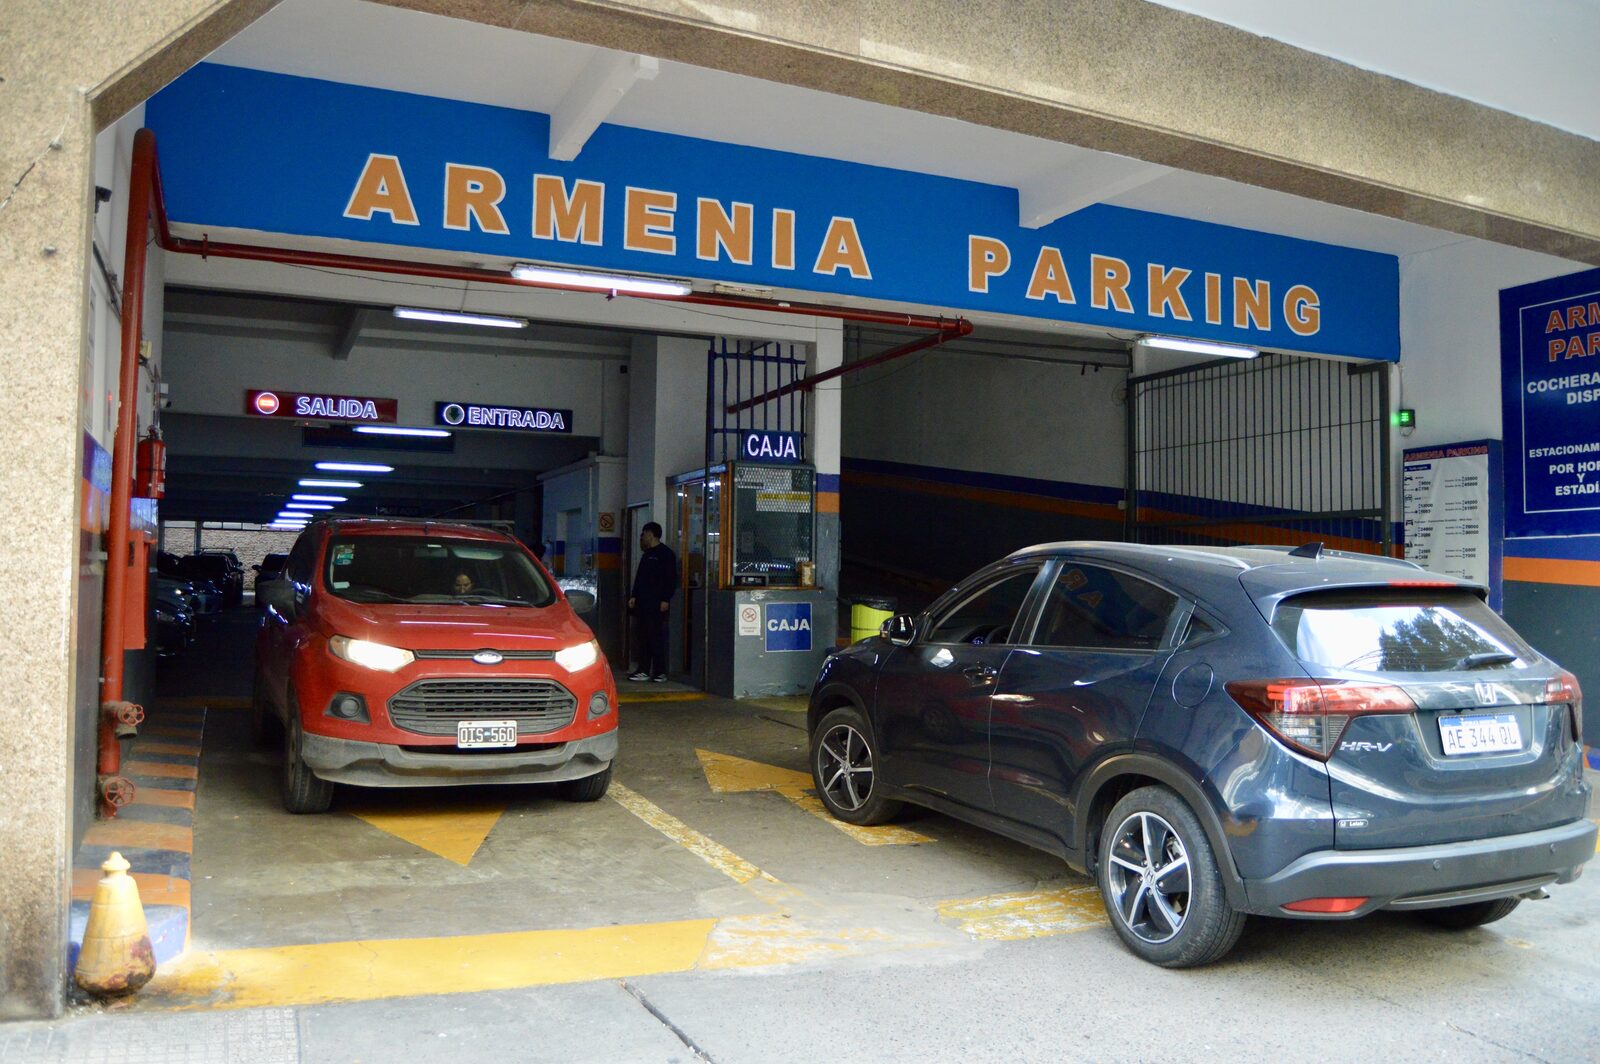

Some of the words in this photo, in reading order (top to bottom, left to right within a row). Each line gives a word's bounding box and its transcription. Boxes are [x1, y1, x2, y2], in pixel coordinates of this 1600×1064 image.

[343, 153, 872, 280] ARMENIA
[968, 234, 1320, 336] PARKING
[1549, 332, 1600, 362] PAR
[1527, 371, 1600, 394] COCHERA
[1566, 388, 1600, 405] DISP
[296, 397, 378, 419] SALIDA
[468, 407, 565, 429] ENTRADA
[747, 433, 797, 458] CAJA
[1529, 442, 1600, 458] ESTACIONAM
[1549, 463, 1575, 475] POR
[1576, 472, 1586, 483] Y
[767, 619, 810, 631] CAJA
[460, 727, 484, 743] OIS
[491, 727, 515, 742] 560
[1448, 728, 1465, 750] AE
[1469, 727, 1496, 748] 344
[1339, 741, 1392, 752] HR-V
